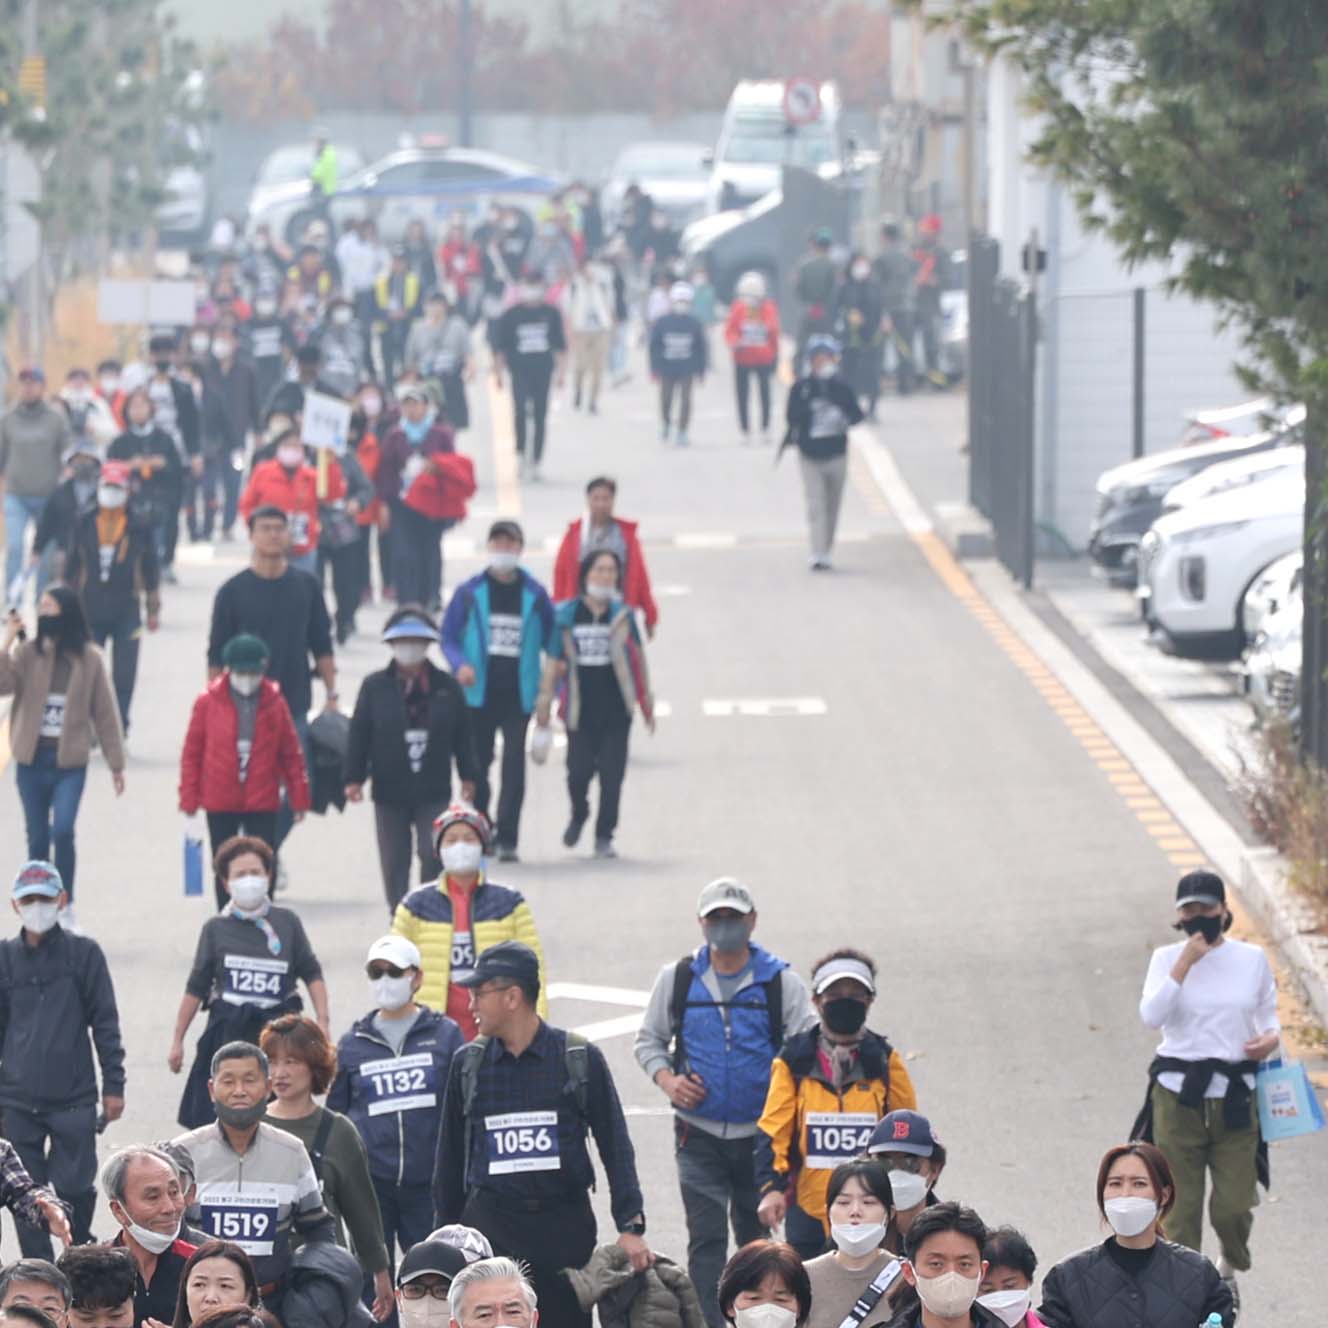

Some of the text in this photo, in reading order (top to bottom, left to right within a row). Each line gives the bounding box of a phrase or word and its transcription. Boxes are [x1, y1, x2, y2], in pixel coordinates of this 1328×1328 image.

[230, 970, 281, 994] 1254
[371, 1068, 426, 1095] 1132
[494, 1128, 552, 1154] 1056
[893, 1121, 910, 1139] B
[211, 1212, 269, 1237] 1519
